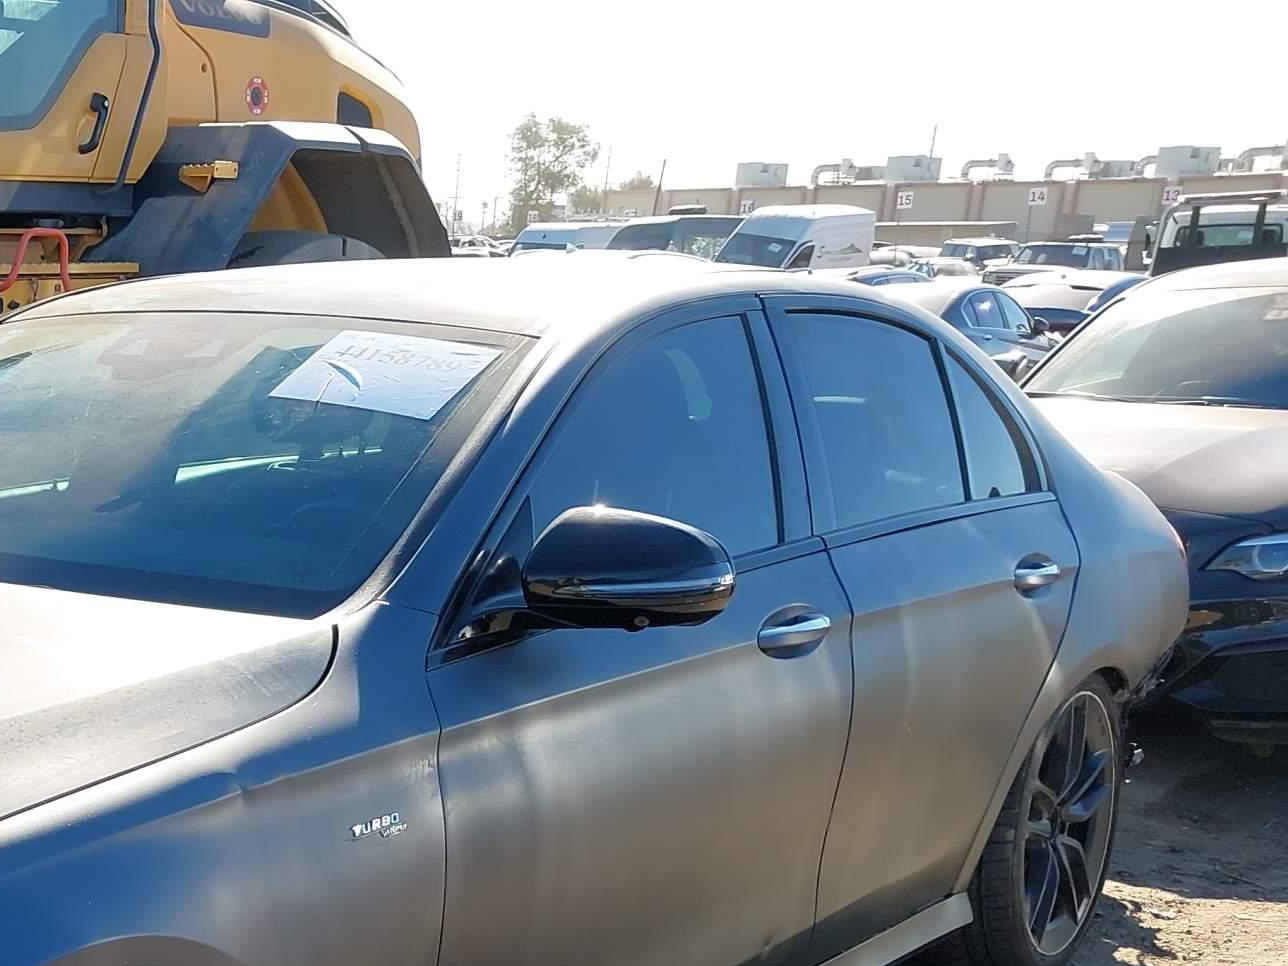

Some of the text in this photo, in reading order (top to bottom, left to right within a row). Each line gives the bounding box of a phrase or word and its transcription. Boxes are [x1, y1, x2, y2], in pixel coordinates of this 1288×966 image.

[899, 194, 912, 206] 15
[1030, 191, 1045, 202] 14
[352, 812, 400, 837] TURBO
